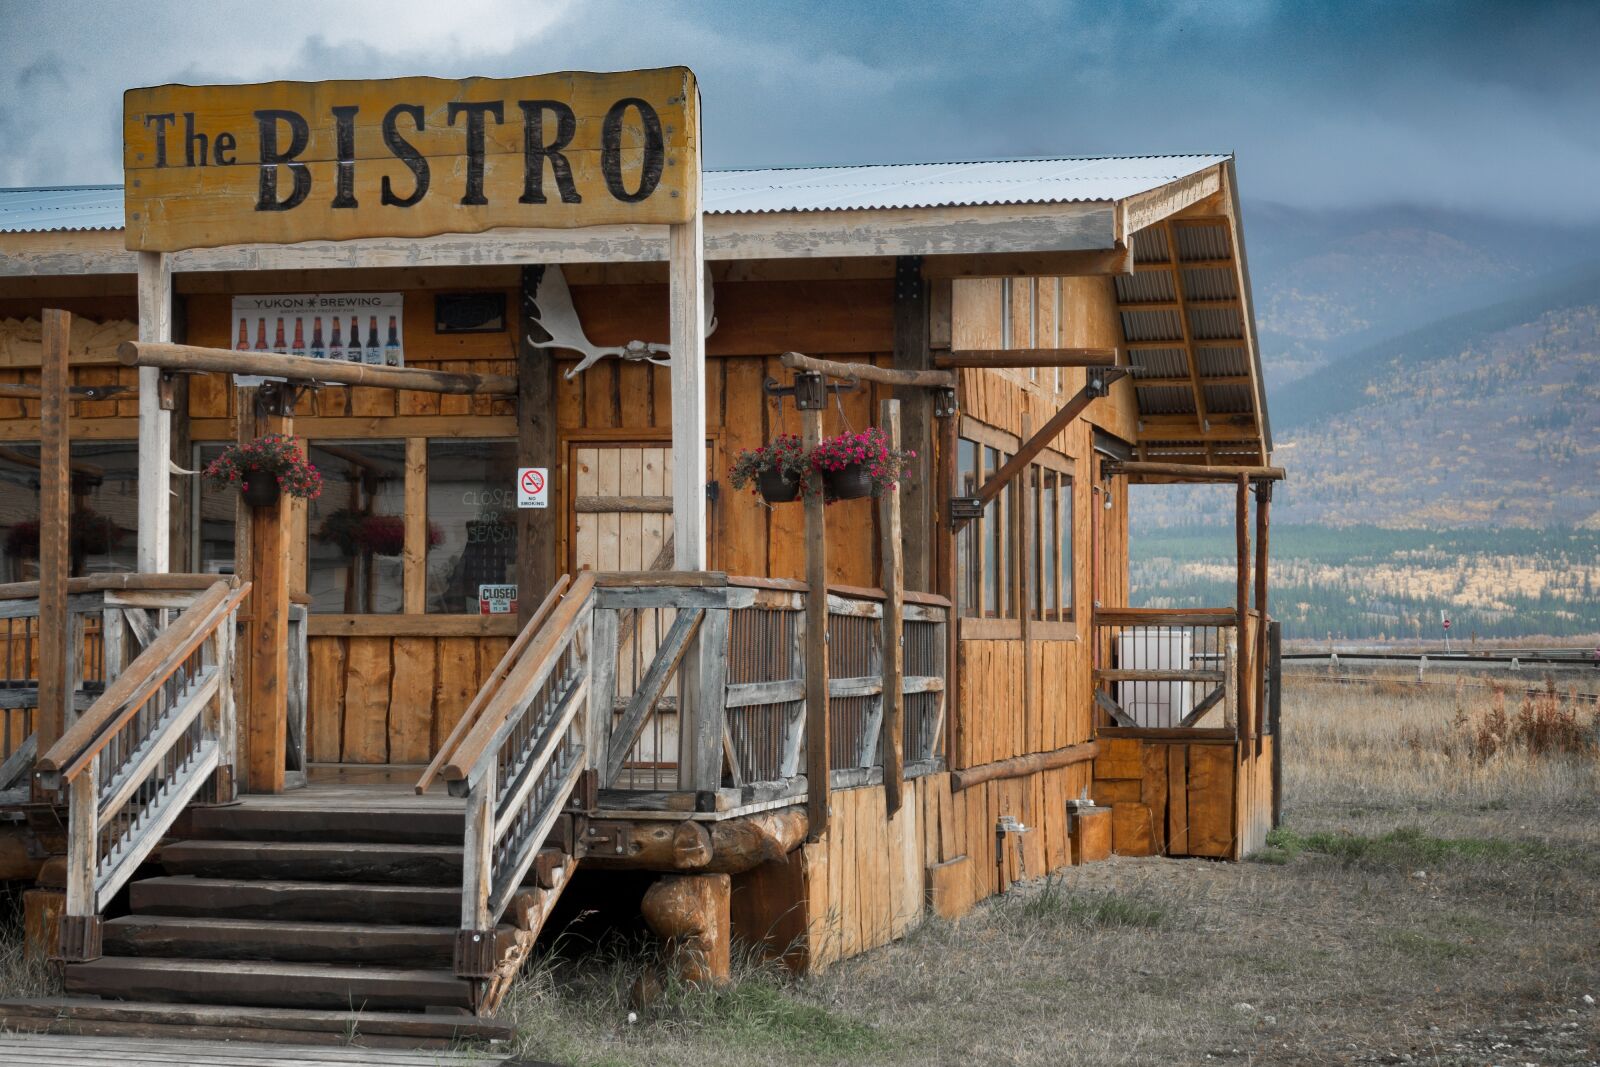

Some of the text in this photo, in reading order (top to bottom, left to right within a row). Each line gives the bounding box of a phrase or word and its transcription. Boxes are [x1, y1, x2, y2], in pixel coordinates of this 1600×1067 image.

[145, 96, 665, 212] The BISTRO
[254, 297, 382, 309] YUKON BREWING
[482, 588, 517, 600] CLOSED
